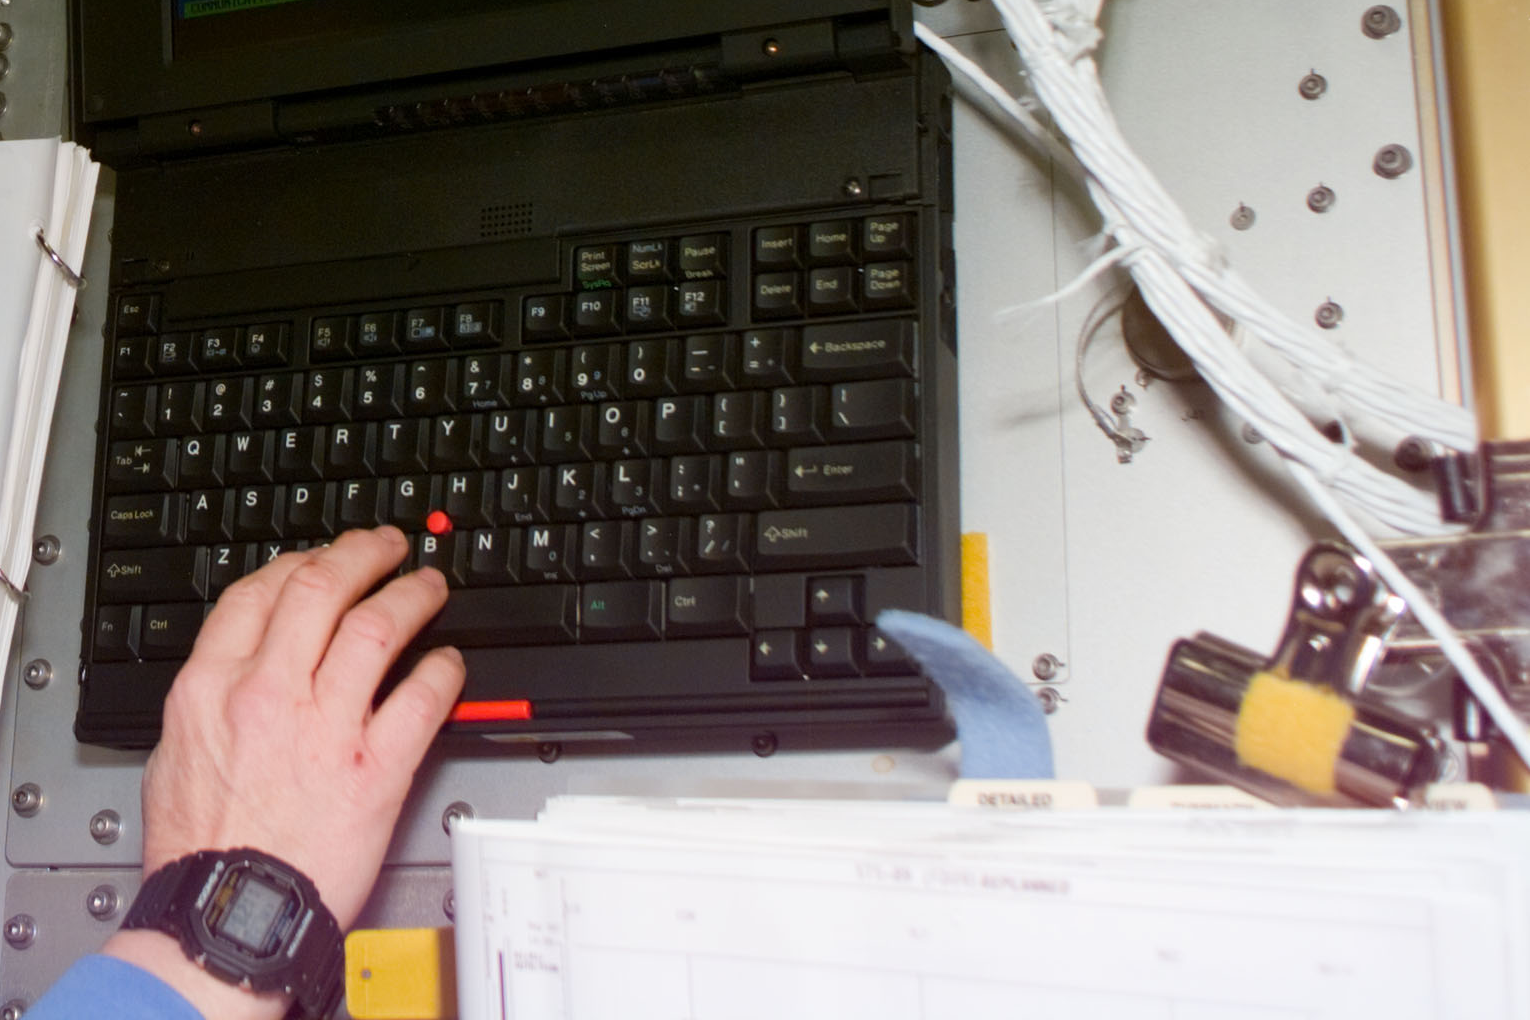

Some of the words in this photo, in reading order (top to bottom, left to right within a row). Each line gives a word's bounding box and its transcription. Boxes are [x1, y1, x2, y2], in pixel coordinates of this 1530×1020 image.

[870, 221, 899, 233] Page
[762, 237, 793, 249] Insert
[815, 232, 846, 244] Home
[870, 234, 885, 245] Up
[633, 243, 663, 254] NumLk
[684, 245, 716, 257] Pause
[581, 251, 606, 262] Print
[581, 261, 611, 272] Screen
[632, 259, 661, 270] ScrLk
[684, 269, 714, 279] Break
[870, 268, 900, 280] Page
[760, 284, 792, 295] Delete
[815, 279, 838, 290] End
[870, 278, 900, 290] Down
[633, 297, 650, 306] F11
[684, 291, 705, 302] F12
[123, 305, 140, 315] Esc
[531, 307, 545, 317] F9
[582, 302, 601, 313] F10
[412, 319, 425, 328] F7
[459, 314, 473, 324] F8
[318, 327, 331, 337] F5
[364, 323, 376, 333] F6
[207, 338, 220, 348] F3
[251, 334, 264, 343] F4
[120, 347, 131, 356] F1
[163, 343, 176, 353] F2
[824, 338, 886, 353] Backspace
[605, 407, 620, 424] O
[662, 402, 675, 419] P
[494, 416, 508, 432] U
[549, 412, 554, 428] I
[389, 424, 401, 440] T
[442, 420, 455, 436] Y
[285, 432, 296, 448] E
[336, 429, 349, 444] R
[187, 440, 200, 456] Q
[237, 436, 250, 451] W
[116, 455, 132, 465] Tab
[618, 465, 631, 482] L
[823, 463, 854, 475] Enter
[507, 473, 518, 490] J
[562, 469, 576, 485] K
[347, 483, 359, 499] F
[400, 480, 414, 496] G
[452, 477, 466, 493] H
[245, 491, 258, 506] S
[296, 488, 309, 503] D
[196, 494, 208, 510] A
[111, 510, 132, 521] Caps
[134, 509, 154, 520] Lock
[533, 530, 549, 546] M
[782, 527, 808, 539] Shift
[424, 537, 436, 552] B
[478, 534, 492, 550] N
[217, 548, 230, 564] Z
[121, 564, 142, 576] Shift
[590, 600, 605, 610] Alt
[675, 595, 696, 606] Ctrl
[102, 622, 113, 631] Fn
[150, 619, 168, 630] Ctrl
[978, 793, 1052, 807] DETAILED
